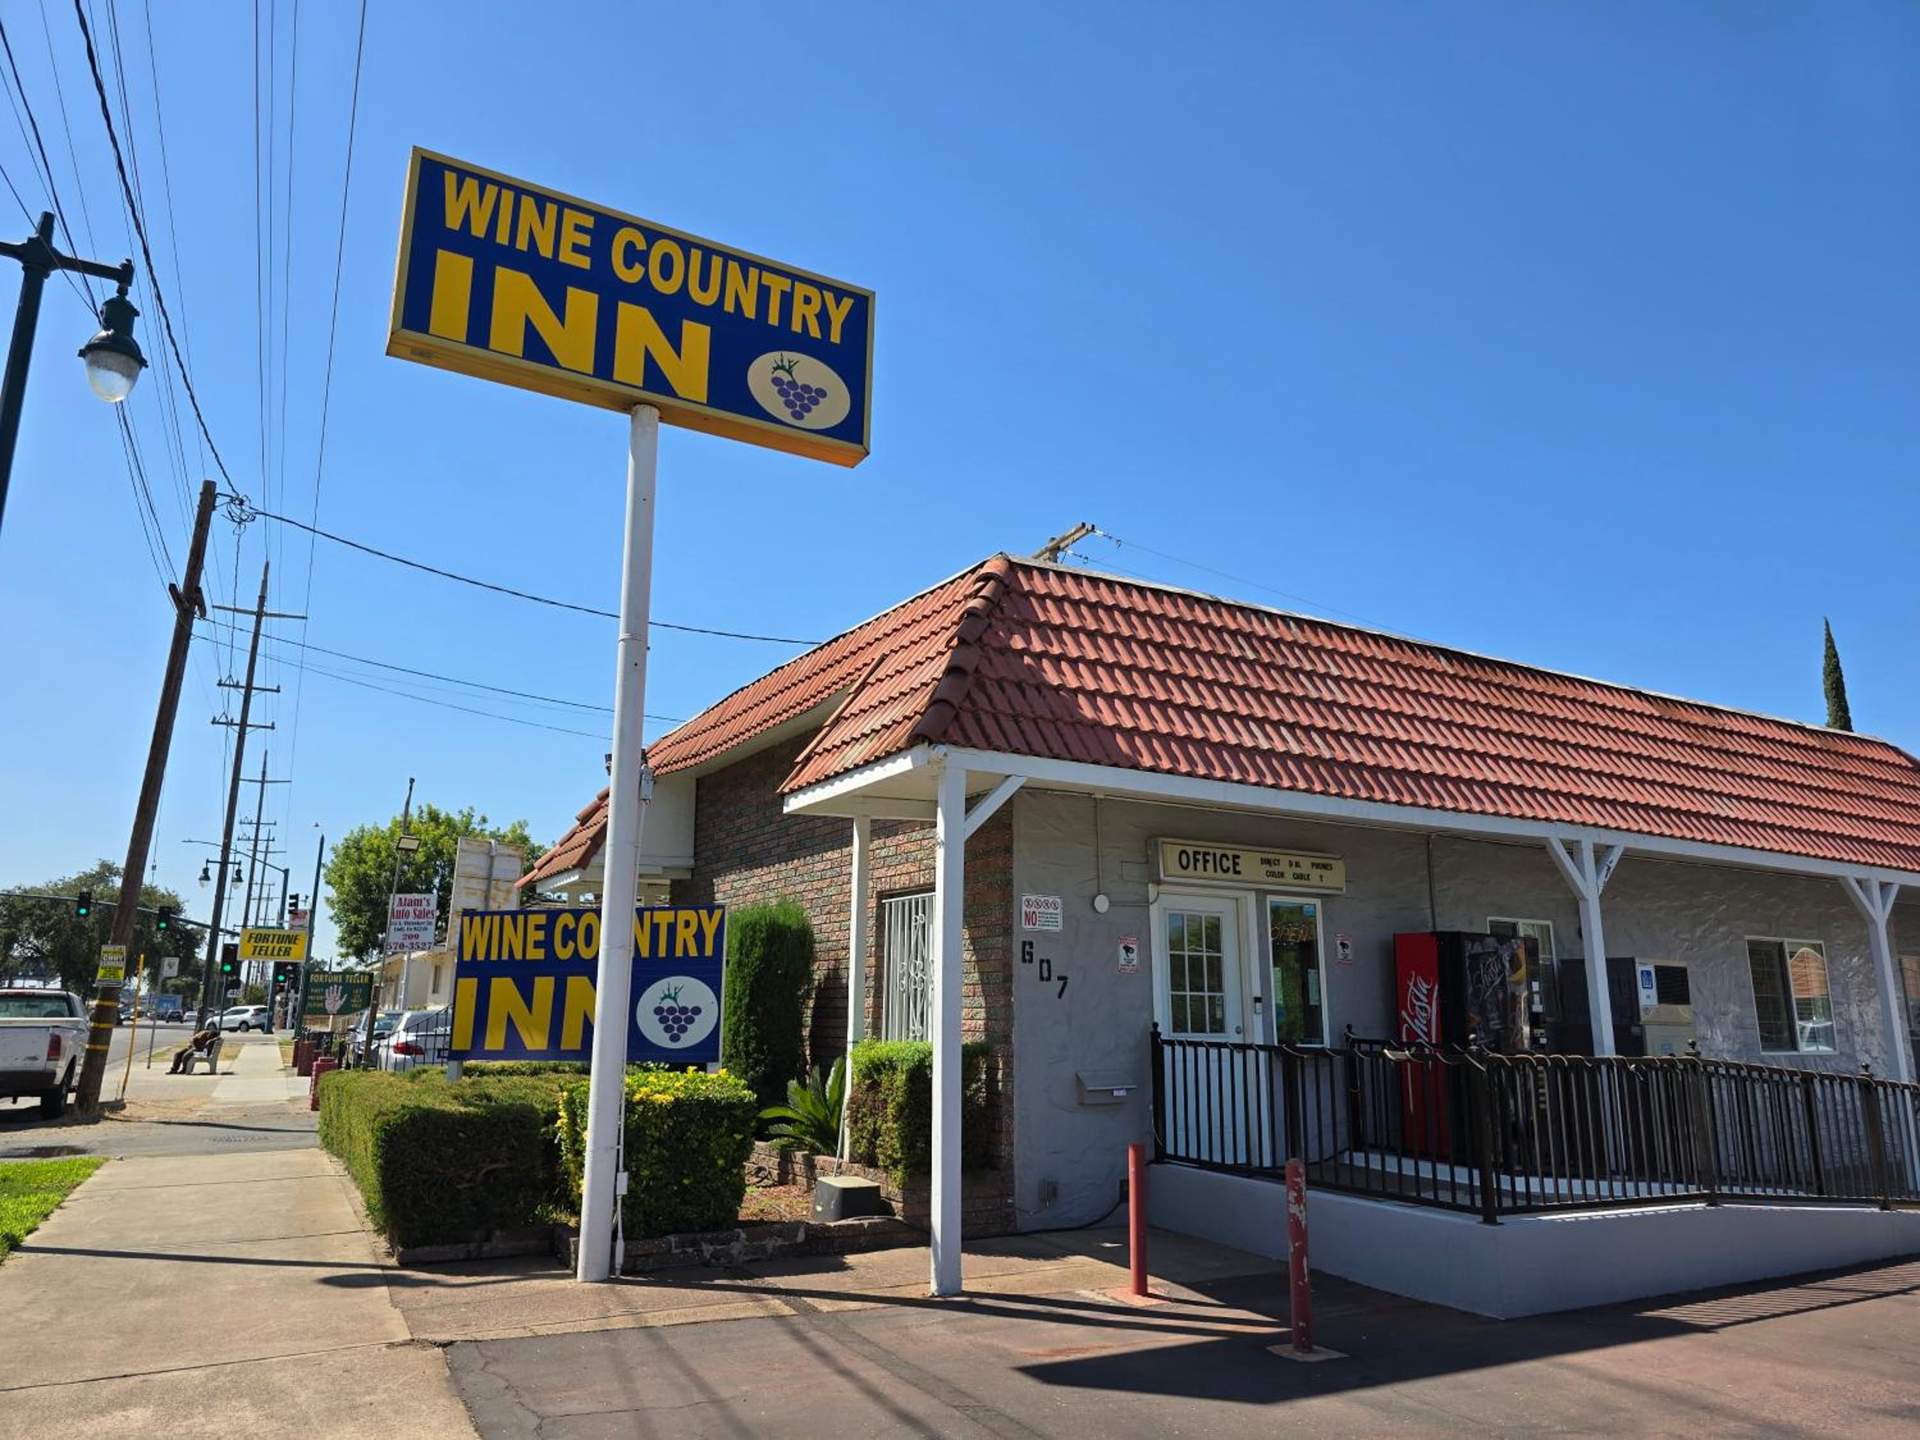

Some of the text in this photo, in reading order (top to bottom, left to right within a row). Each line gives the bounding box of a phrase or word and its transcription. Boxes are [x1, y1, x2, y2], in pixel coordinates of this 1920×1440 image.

[444, 170, 854, 344] WINE COUNTRY
[429, 249, 711, 404] INN
[1178, 849, 1241, 875] OFFICE
[413, 908, 435, 919] Sales
[1024, 910, 1038, 927] NO
[247, 932, 300, 945] FORTUNE
[462, 908, 723, 961] WINE CONTRY
[251, 945, 292, 957] TELLER
[1021, 940, 1069, 1000] 607
